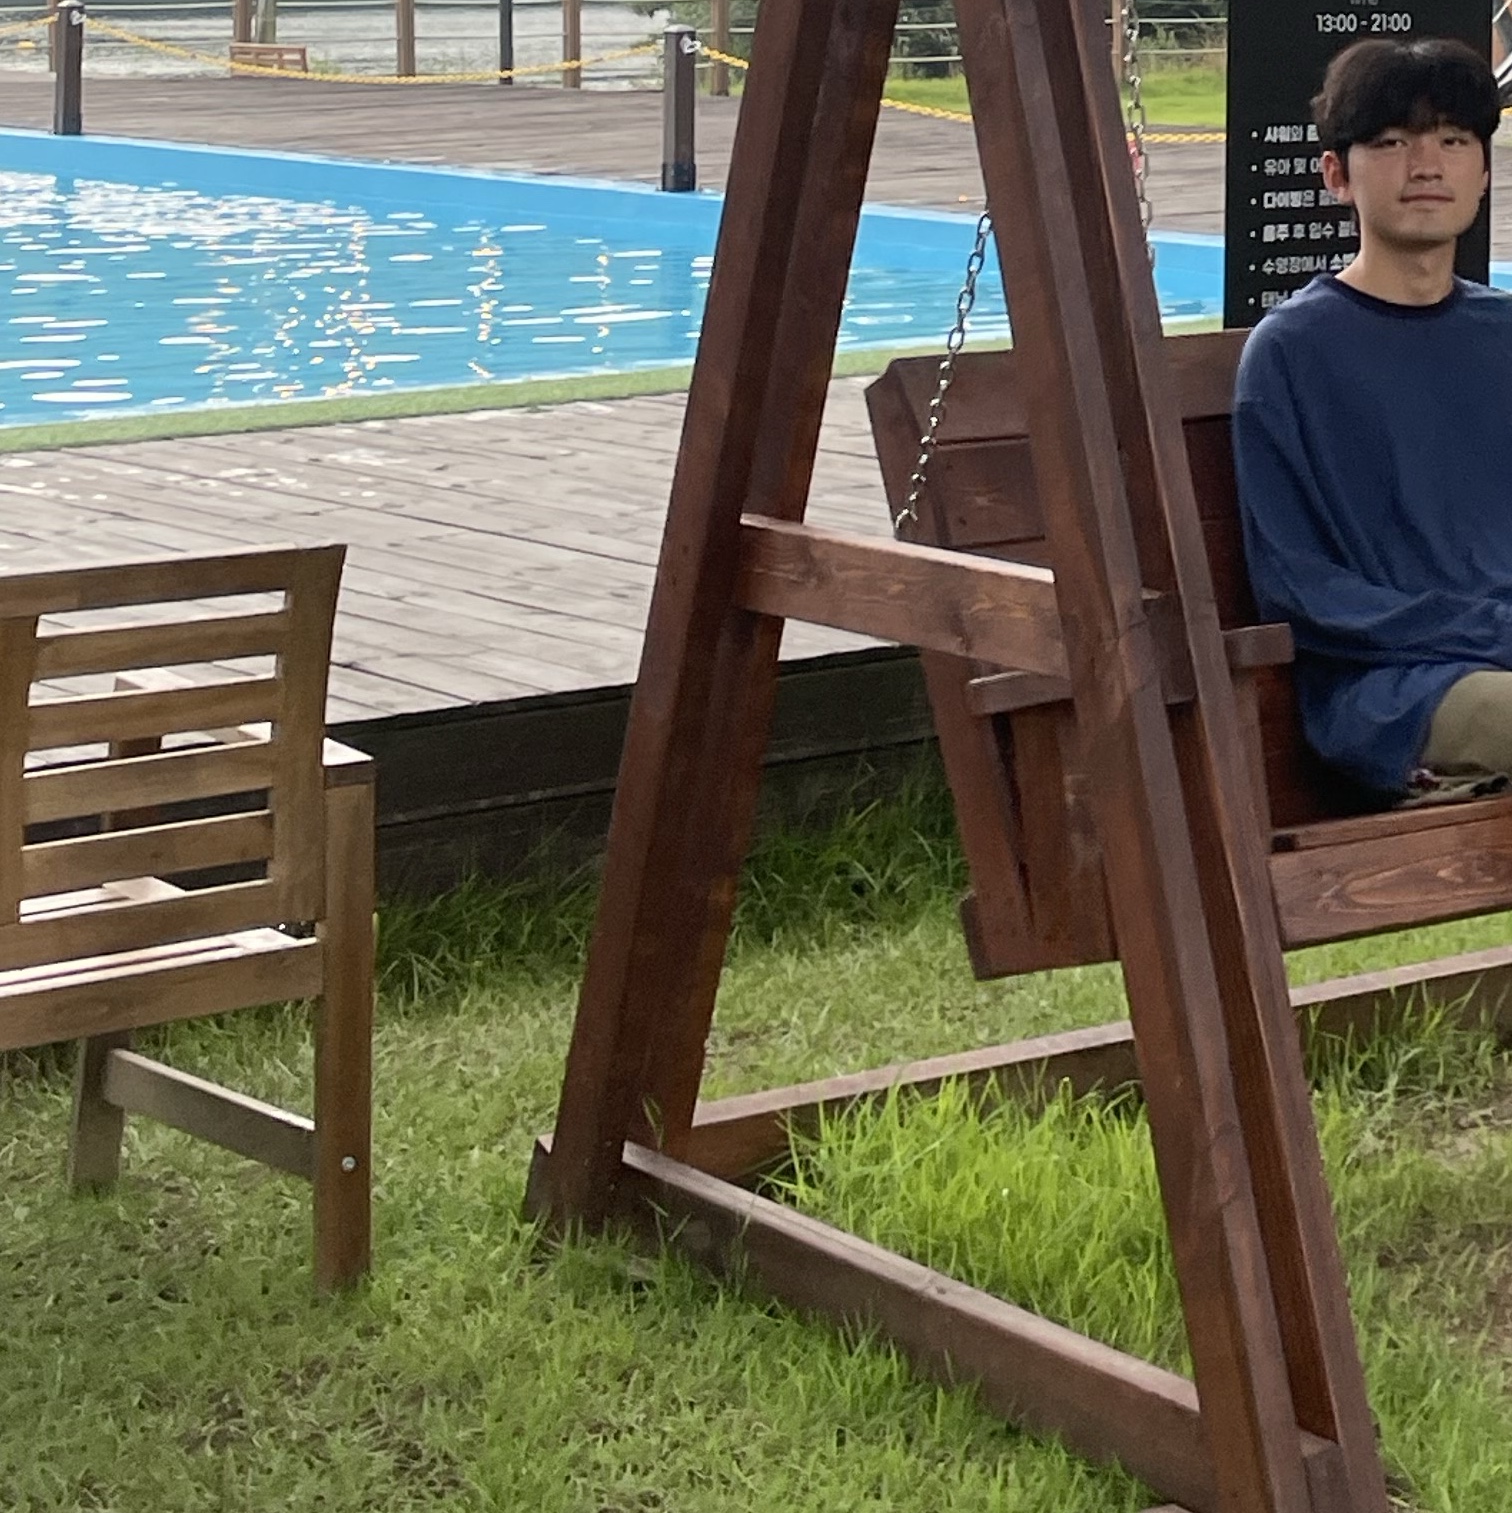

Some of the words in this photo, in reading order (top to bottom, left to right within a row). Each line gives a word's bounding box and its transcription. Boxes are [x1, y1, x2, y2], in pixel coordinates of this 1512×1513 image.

[1316, 14, 1357, 32] 13:00
[1370, 13, 1412, 31] 21:00
[1264, 158, 1291, 176] 유아
[1263, 189, 1315, 209] 다이빙은
[1262, 254, 1327, 275] 수영장에서
